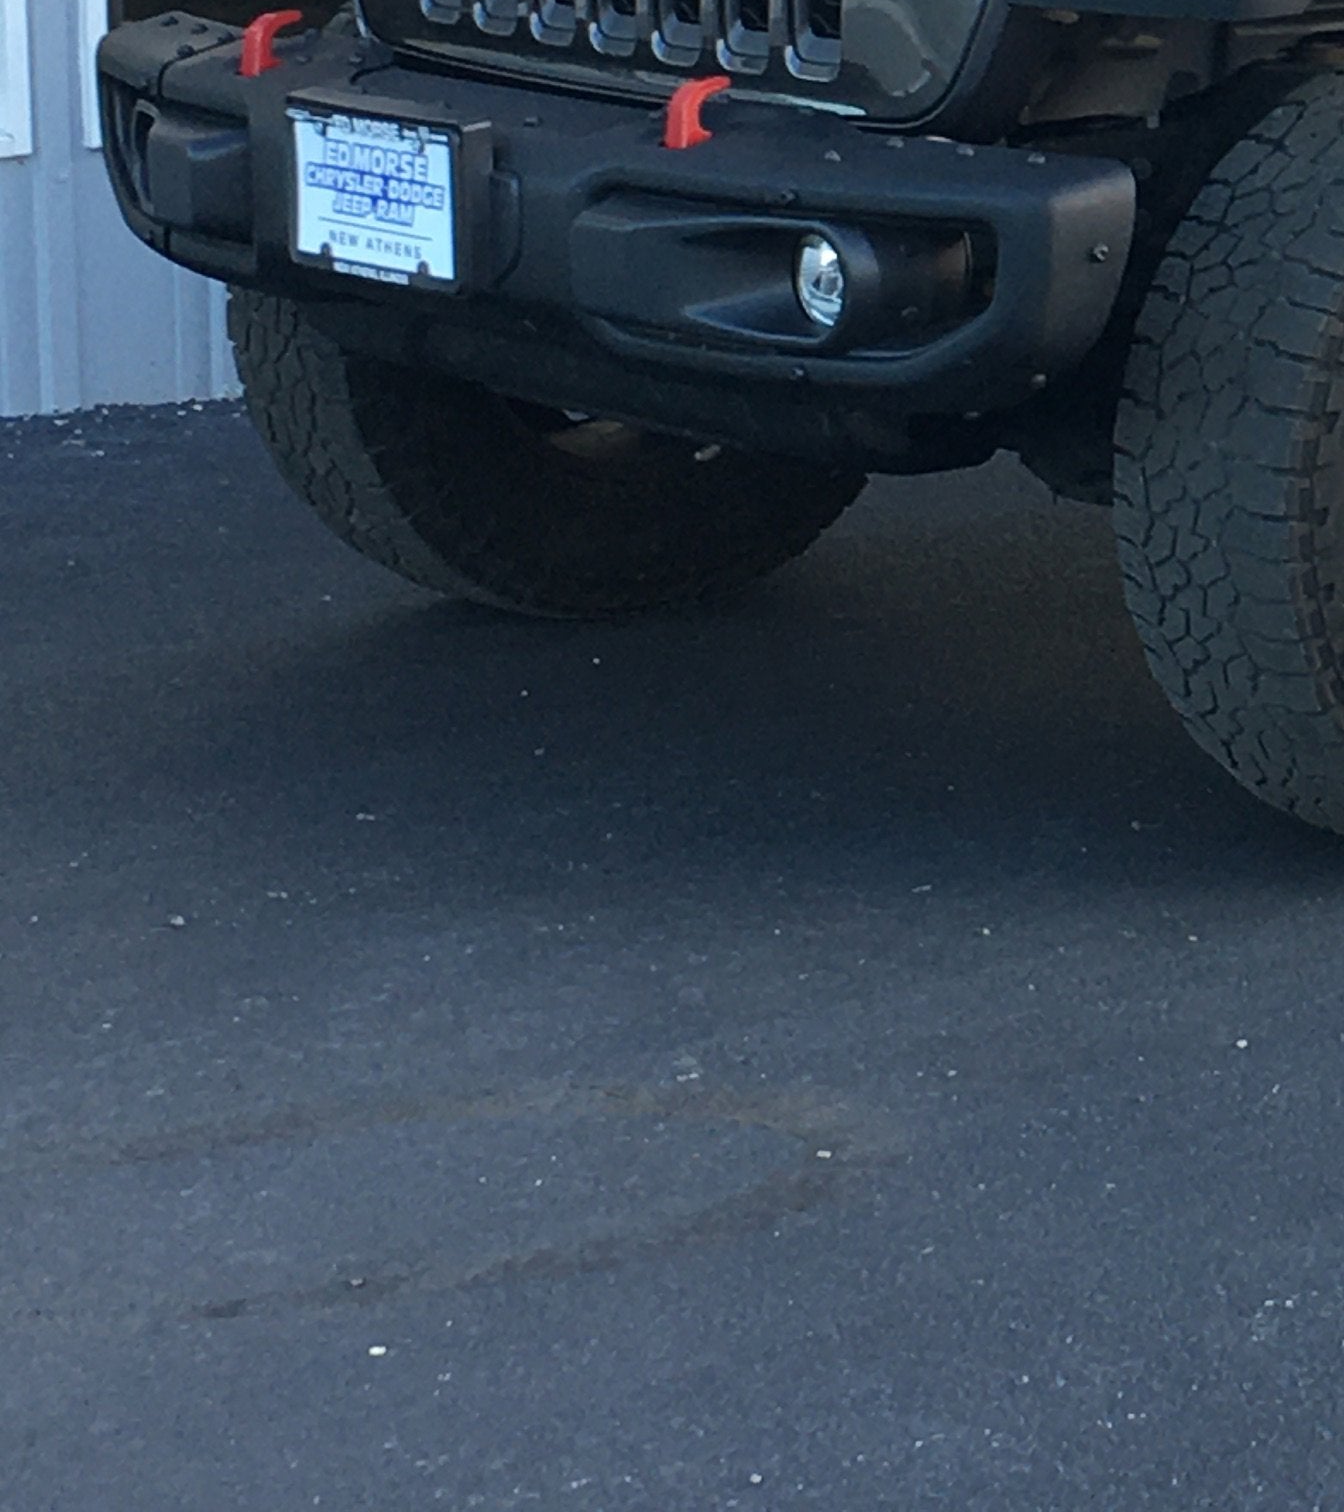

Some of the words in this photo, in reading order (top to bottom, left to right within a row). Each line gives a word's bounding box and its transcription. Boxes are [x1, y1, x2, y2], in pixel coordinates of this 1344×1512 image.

[325, 141, 350, 164] ED
[352, 143, 428, 181] MORSE
[306, 163, 384, 197] CHRYSLER
[388, 179, 445, 210] DODGE
[333, 192, 372, 218] JEEP
[374, 199, 415, 227] RAM
[329, 230, 359, 248] NEW
[365, 238, 423, 260] ATHENS
